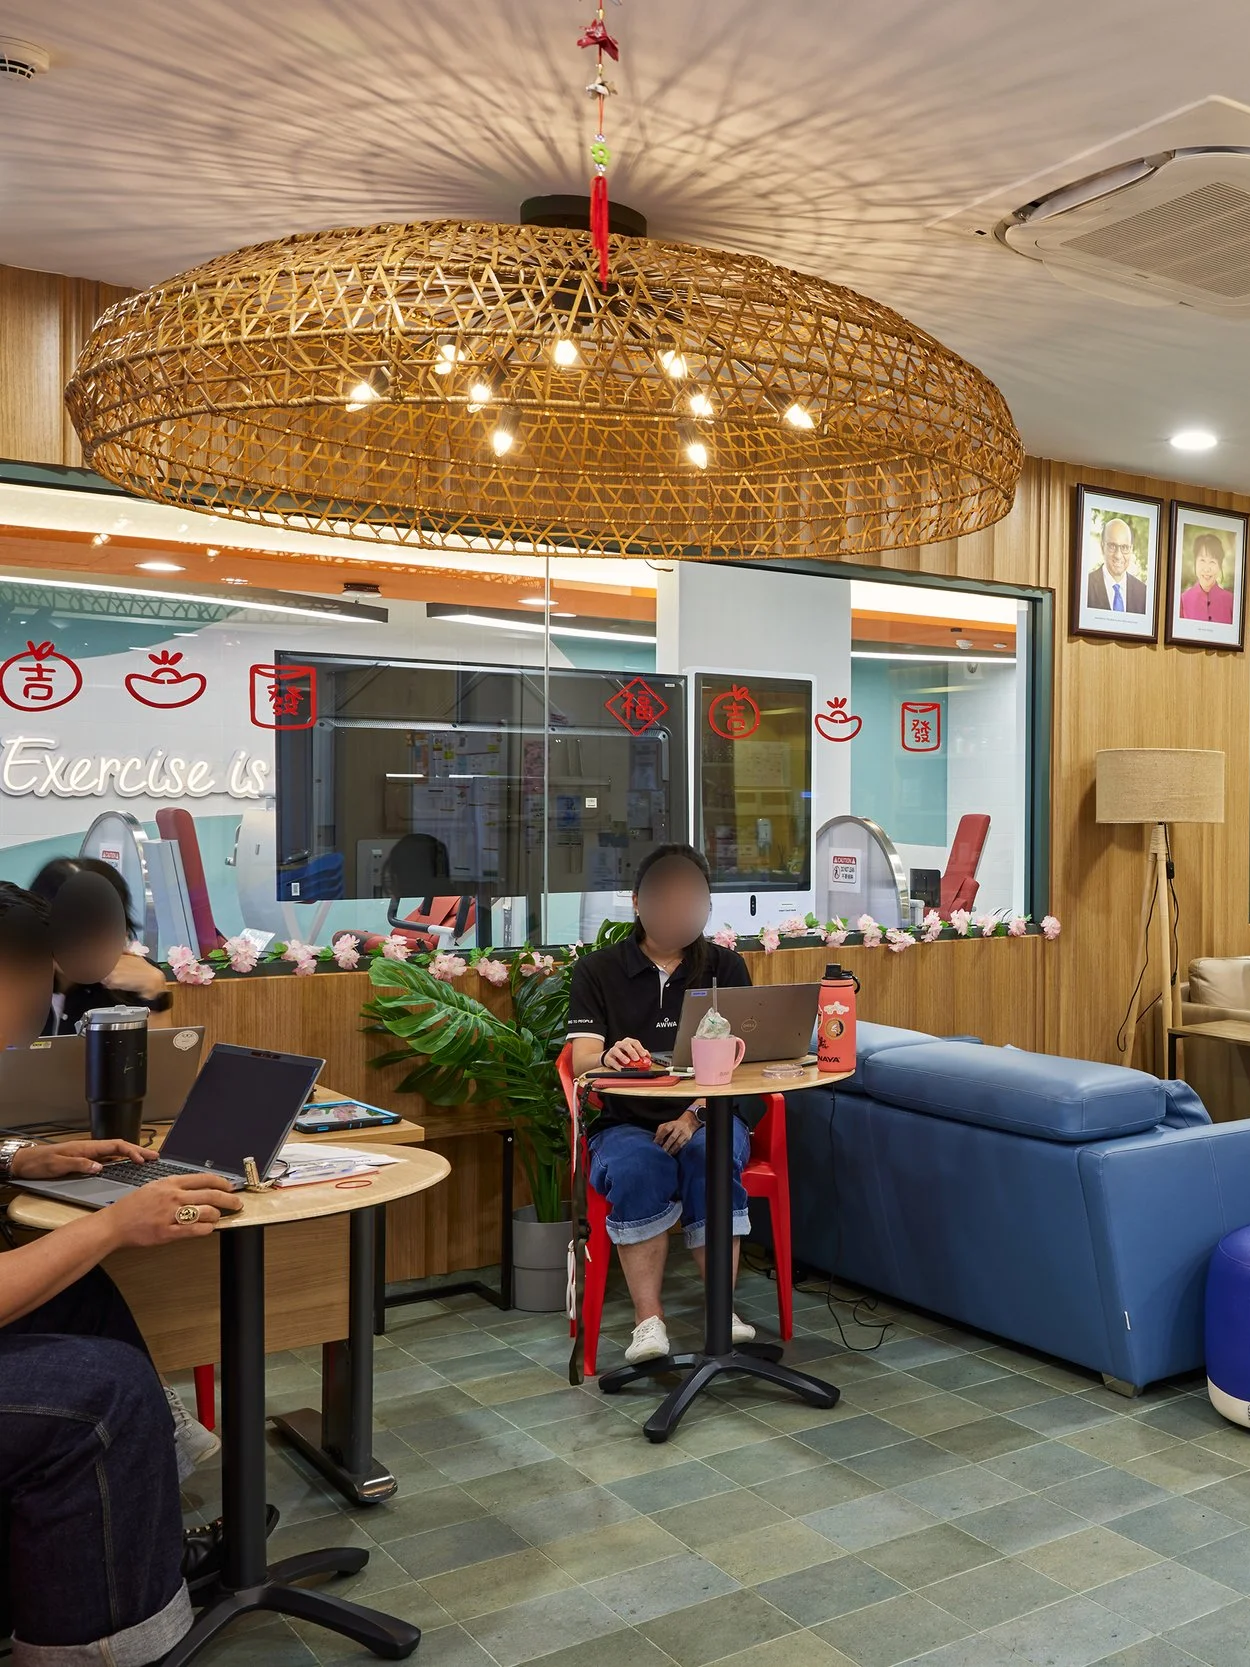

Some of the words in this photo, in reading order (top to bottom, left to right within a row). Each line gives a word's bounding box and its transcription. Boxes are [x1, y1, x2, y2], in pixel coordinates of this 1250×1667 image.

[19, 662, 56, 700] 吉
[267, 684, 303, 717] 發
[621, 690, 655, 721] 福
[722, 702, 746, 731] 吉
[911, 719, 933, 744] 發
[2, 735, 223, 800] Exercise
[229, 748, 272, 800] is
